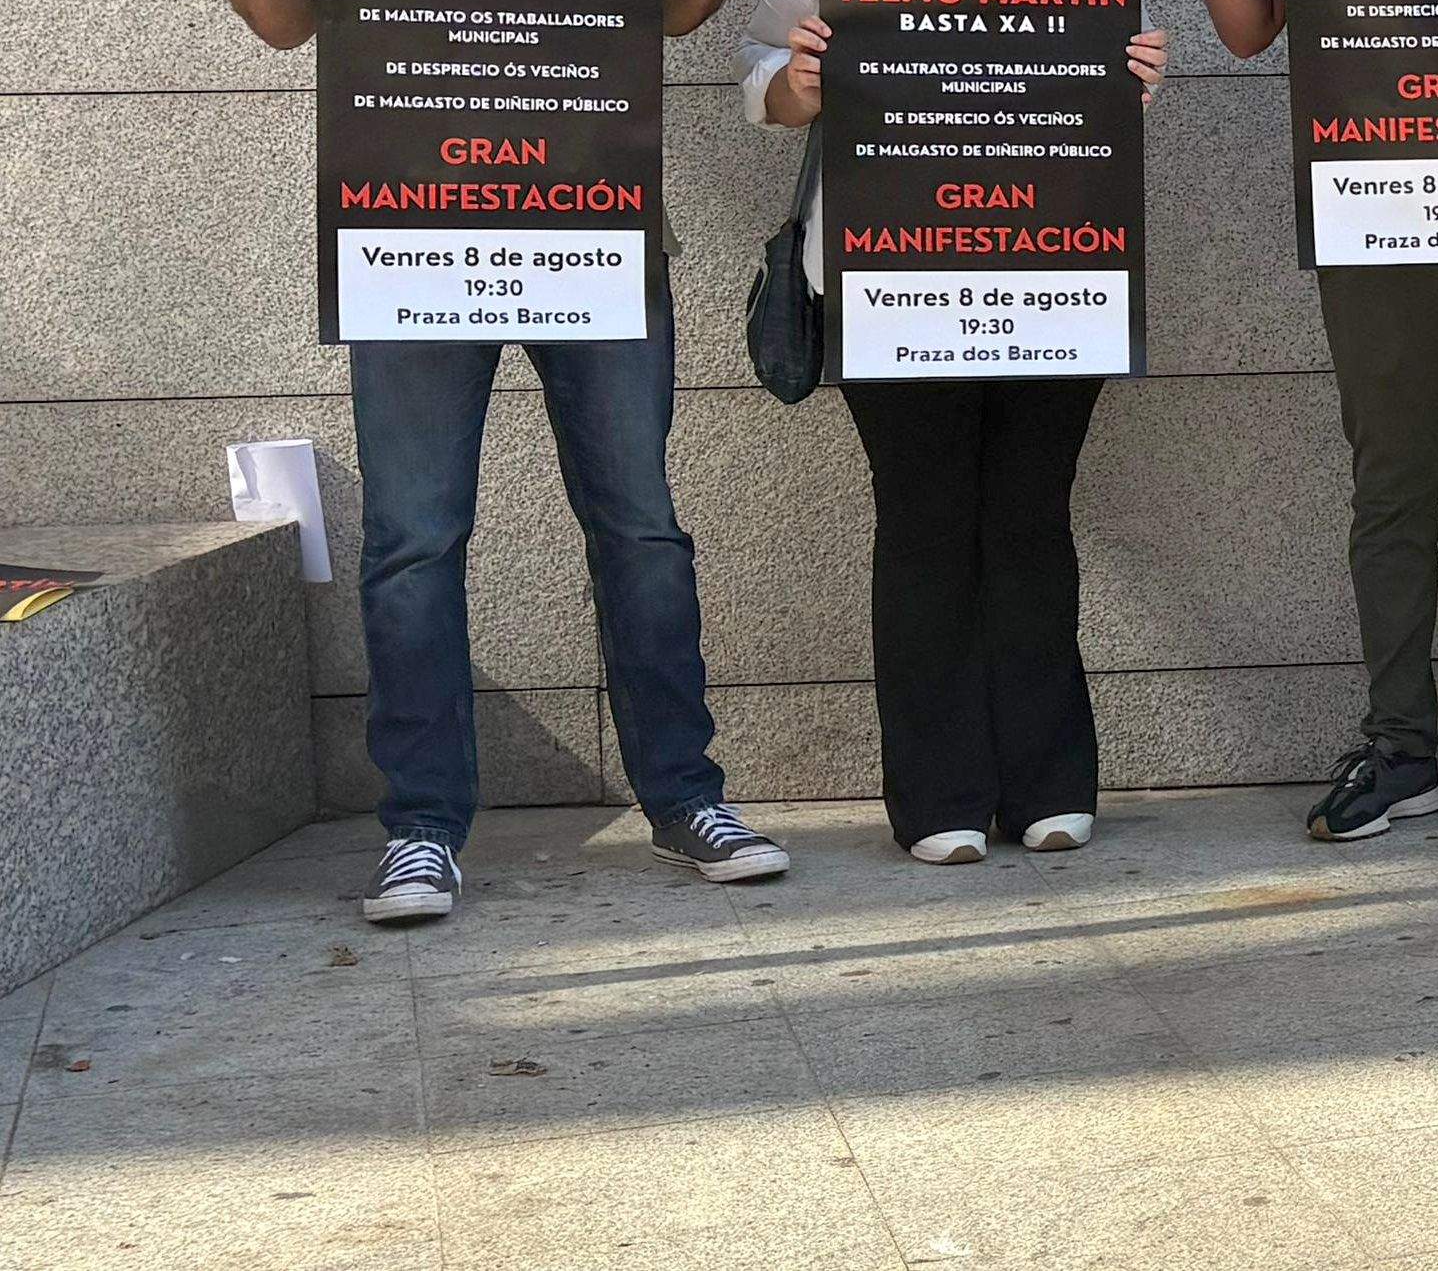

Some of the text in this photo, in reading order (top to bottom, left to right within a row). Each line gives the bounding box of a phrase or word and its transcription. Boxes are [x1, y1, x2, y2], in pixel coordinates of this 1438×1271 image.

[359, 8, 625, 28] DE MALTRATO OS TRABALLADORES
[900, 13, 988, 33] BASTA
[998, 14, 1036, 33] XA
[448, 29, 540, 45] MUNICIPAIS
[386, 61, 600, 79] DE DESPRECIO ÓS VECIÑOS
[354, 94, 629, 112] DE MALGASTO DE DIÑEIRO PÚBLICO
[440, 137, 548, 166] GRAN
[341, 178, 644, 213] MANIFESTACIÓN
[935, 183, 1036, 211] GRAN
[844, 222, 1127, 255] MANIFESTACIÓN
[1365, 233, 1421, 249] Praza
[361, 246, 622, 272] Venres 8 de agosto
[464, 279, 523, 297] 19:30
[864, 287, 1108, 312] Venres 8 de agosto
[397, 307, 591, 325] Praza dos Barcos
